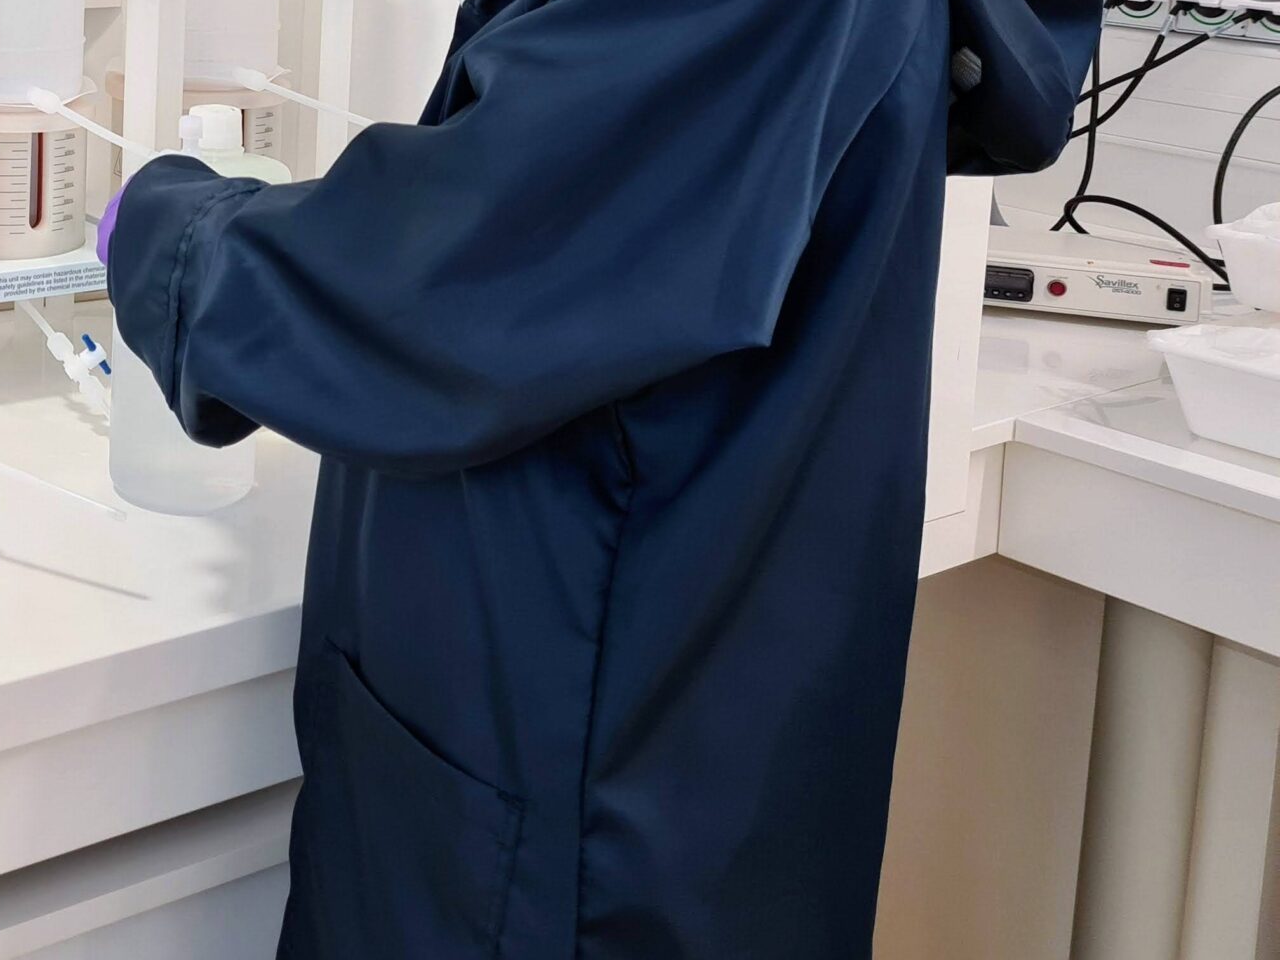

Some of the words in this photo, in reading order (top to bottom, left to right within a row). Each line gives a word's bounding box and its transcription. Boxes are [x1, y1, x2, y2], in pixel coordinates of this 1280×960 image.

[20, 275, 32, 283] may
[33, 271, 53, 279] contain
[53, 268, 82, 277] hazardous
[1094, 275, 1139, 290] Savillex
[0, 282, 15, 291] safety
[16, 279, 45, 289] guidelines
[3, 287, 28, 298] provided
[28, 287, 36, 295] by
[46, 283, 71, 292] chemical
